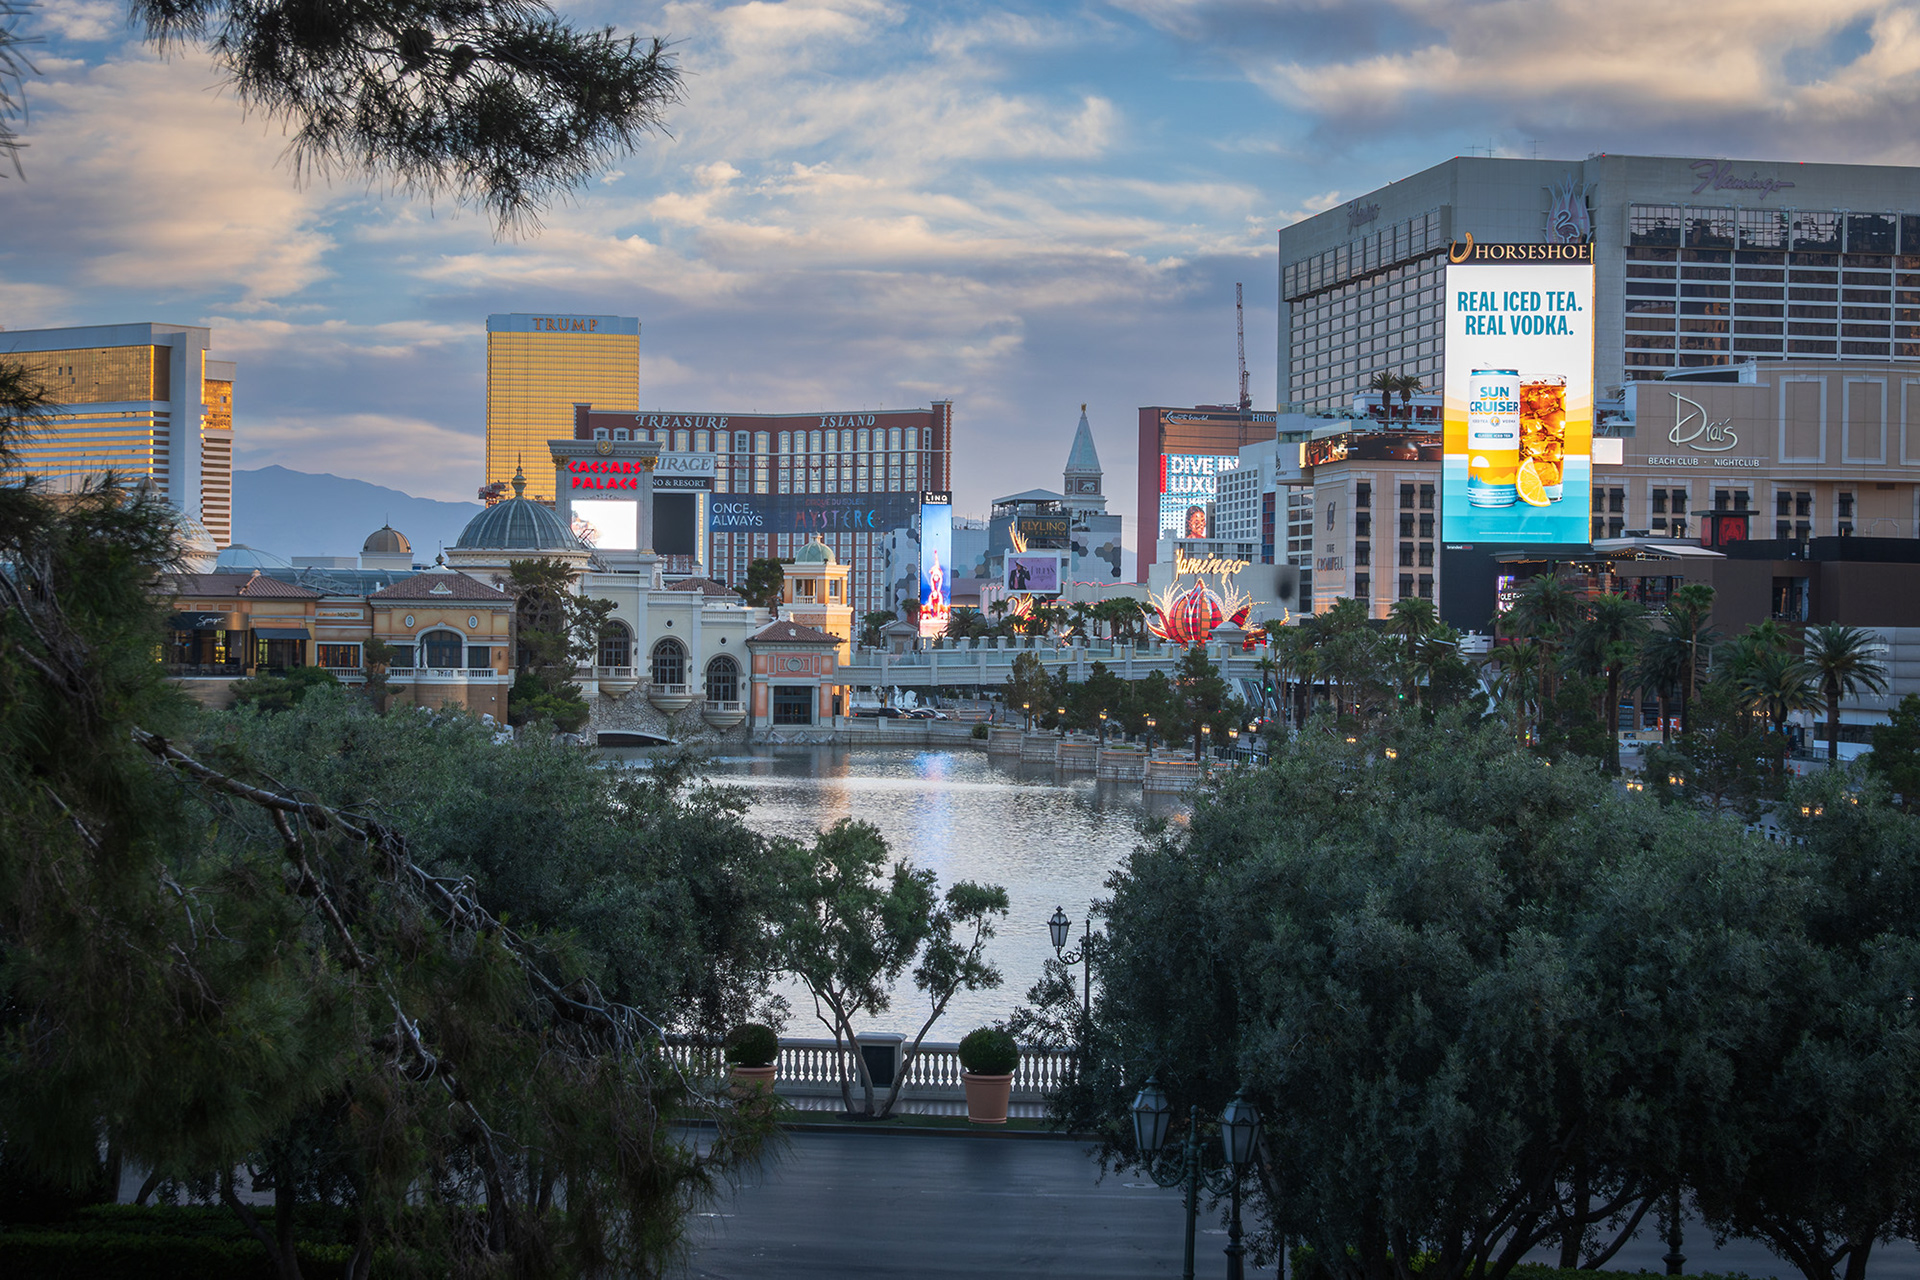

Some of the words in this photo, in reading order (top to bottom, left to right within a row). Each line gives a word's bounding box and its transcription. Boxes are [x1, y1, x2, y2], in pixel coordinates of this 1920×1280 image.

[1689, 160, 1795, 200] Flamingo
[1457, 291, 1498, 312] REAL
[1503, 291, 1541, 312] ICED
[1546, 291, 1583, 312] TEA.
[532, 318, 598, 331] TRUMP
[1465, 315, 1506, 335] REAL
[1510, 315, 1574, 335] VODKA.
[1480, 386, 1509, 398] SUN
[1470, 401, 1519, 412] CRUISER
[636, 415, 729, 430] TREASURE
[819, 414, 874, 429] ISLAND
[1252, 414, 1276, 422] Hilto
[568, 460, 641, 474] CAESARS
[1171, 456, 1214, 474] DIVE
[1677, 458, 1699, 466] CLUB
[1714, 459, 1760, 467] NIGHTCLUB
[572, 476, 639, 490] PALACE
[832, 498, 841, 506] DU
[712, 503, 753, 516] ONCE,
[712, 515, 763, 527] ALWAYS
[1326, 544, 1334, 553] THE
